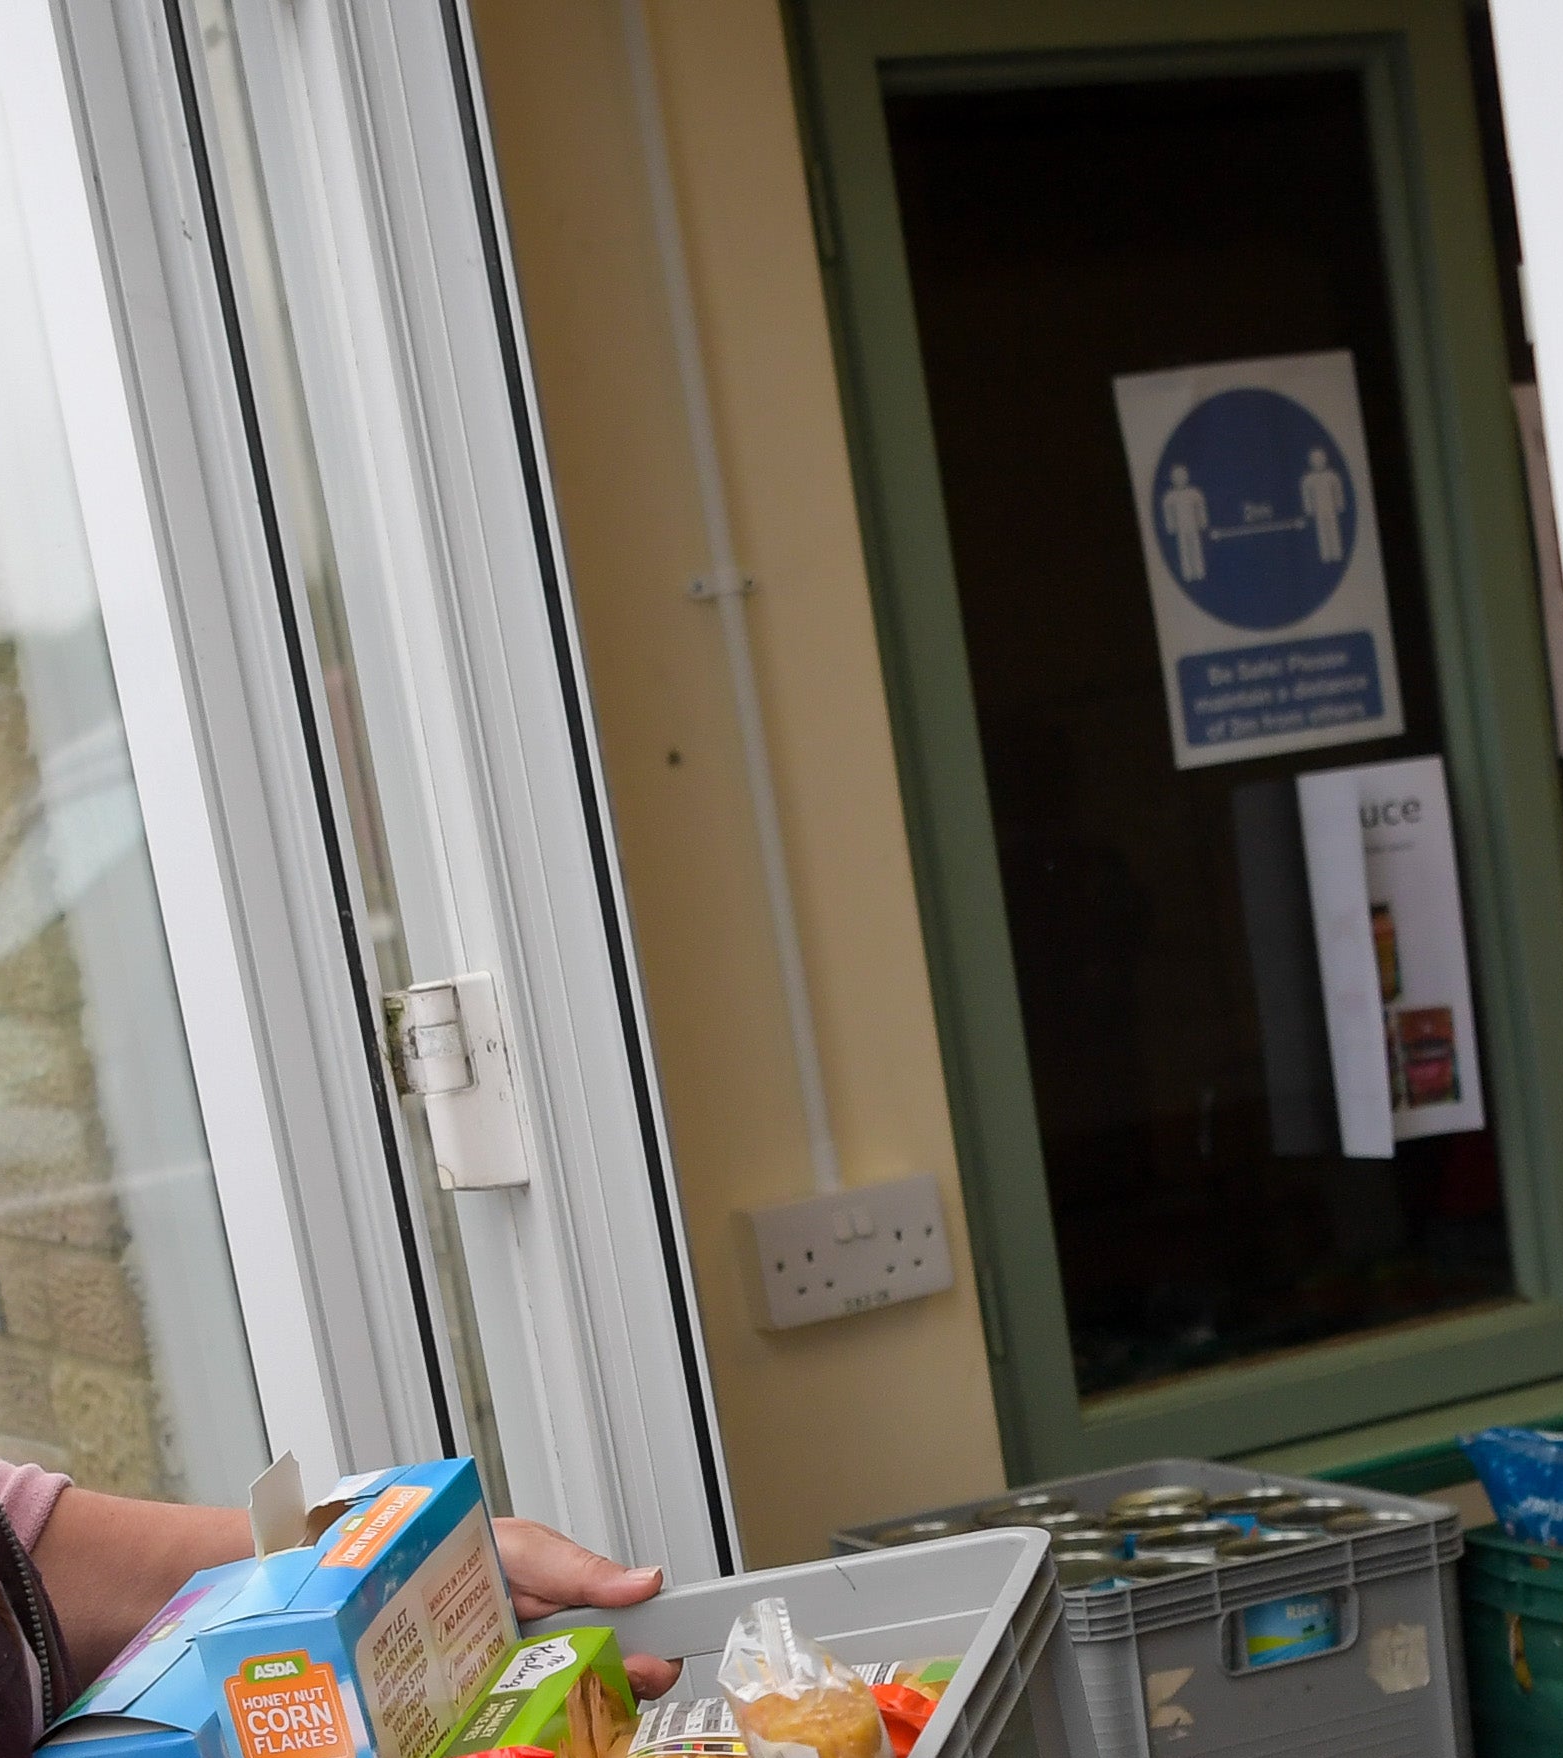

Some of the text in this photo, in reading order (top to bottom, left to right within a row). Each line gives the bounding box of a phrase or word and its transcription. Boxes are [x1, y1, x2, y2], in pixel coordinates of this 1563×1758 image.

[1359, 803, 1422, 830] uce
[393, 1608, 407, 1634] LET
[444, 1614, 455, 1635] NO
[455, 1576, 491, 1624] ARTIFICIAL
[253, 1660, 299, 1680] ASDA
[373, 1621, 418, 1687] BLEARY EYES
[390, 1639, 424, 1690] MORNING
[459, 1662, 480, 1696] HIGH
[486, 1631, 506, 1664] IRON
[499, 1643, 556, 1690] Kipling
[408, 1657, 428, 1690] STOP
[241, 1686, 324, 1710] HONEY NUT
[247, 1701, 333, 1735] CORN
[393, 1709, 407, 1738] YOU
[253, 1727, 338, 1755] FLAKES
